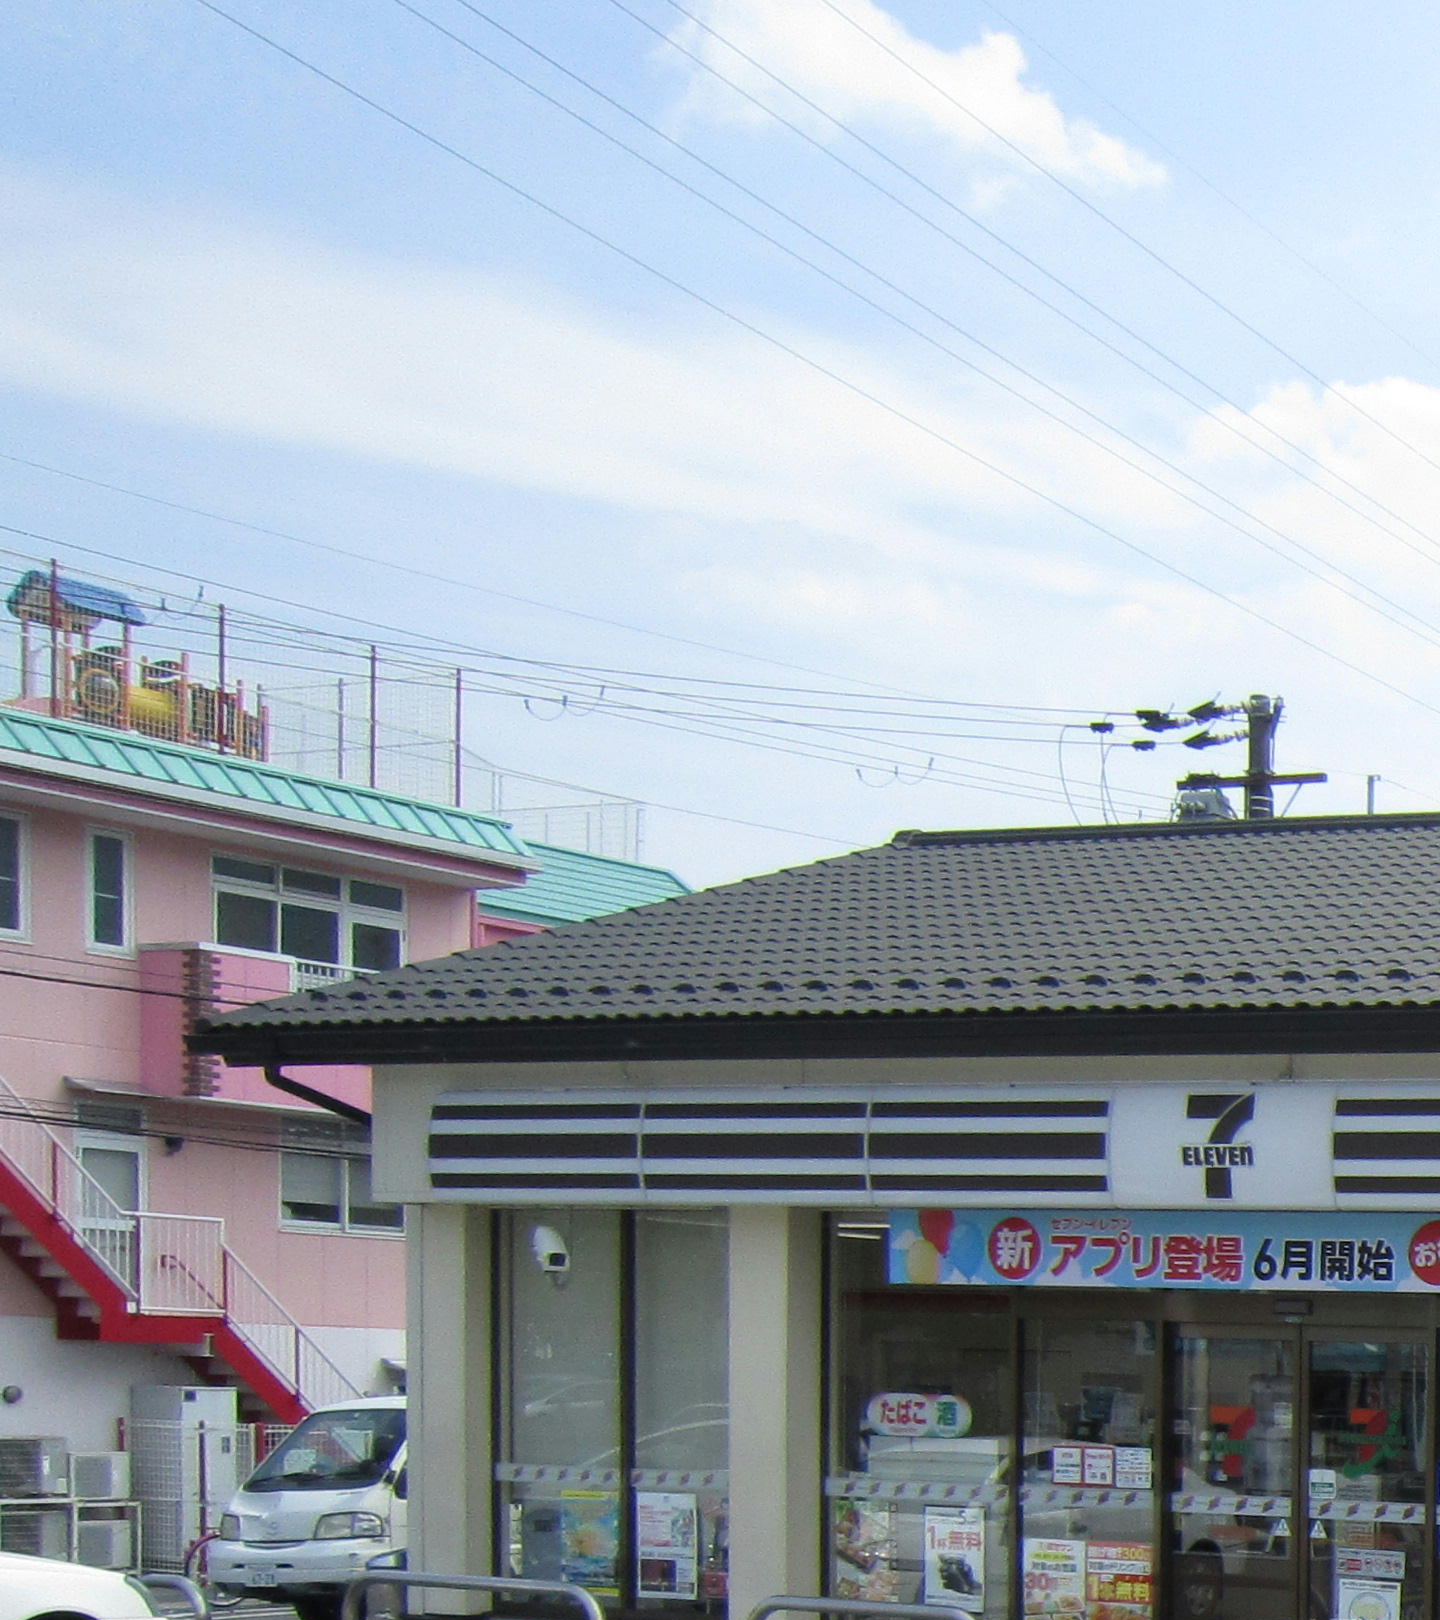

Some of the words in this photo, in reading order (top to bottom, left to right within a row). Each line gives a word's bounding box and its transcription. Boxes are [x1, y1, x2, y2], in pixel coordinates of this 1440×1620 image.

[1186, 1092, 1255, 1199] 7
[998, 1228, 1033, 1271] 新
[1050, 1232, 1244, 1282] アプリ登場
[1253, 1238, 1396, 1282] 6月開始
[880, 1400, 927, 1425] たばこ
